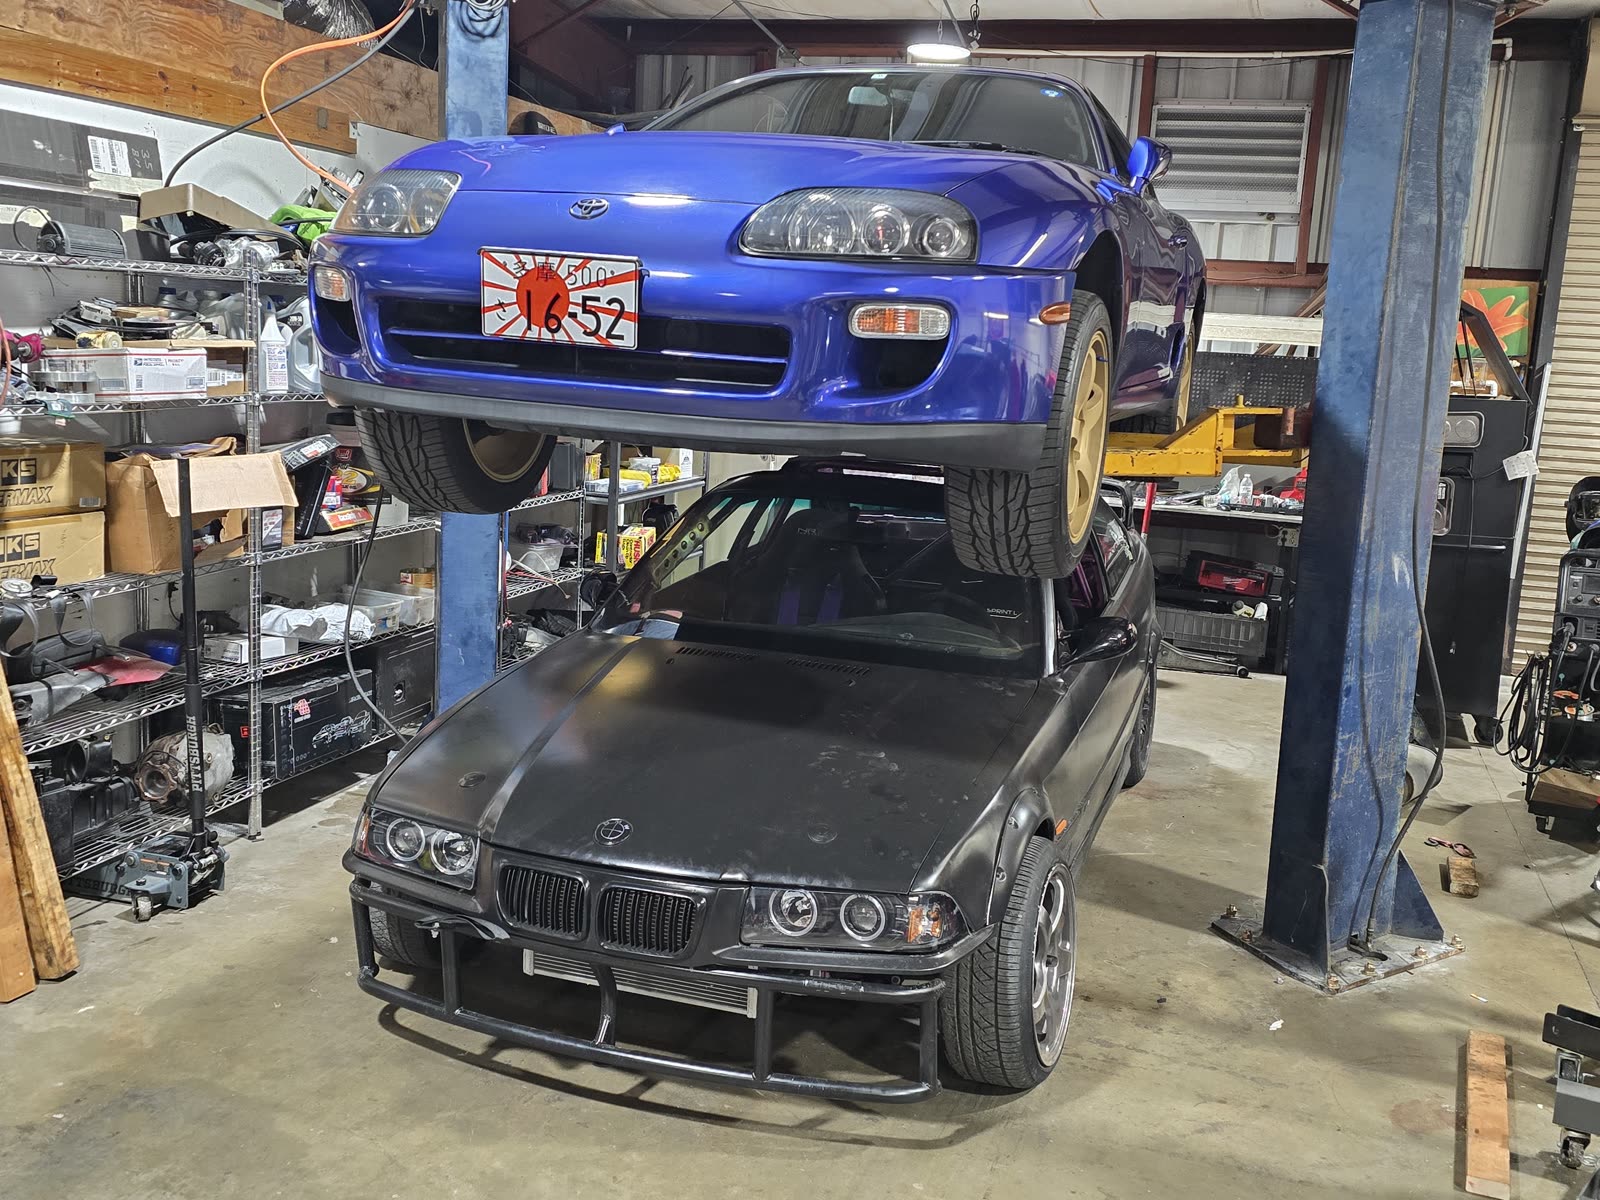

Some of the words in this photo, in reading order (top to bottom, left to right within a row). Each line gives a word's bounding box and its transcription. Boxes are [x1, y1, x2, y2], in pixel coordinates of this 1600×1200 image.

[567, 264, 607, 288] 500
[526, 290, 626, 341] 16-52
[186, 714, 203, 792] PITTSBURGH
